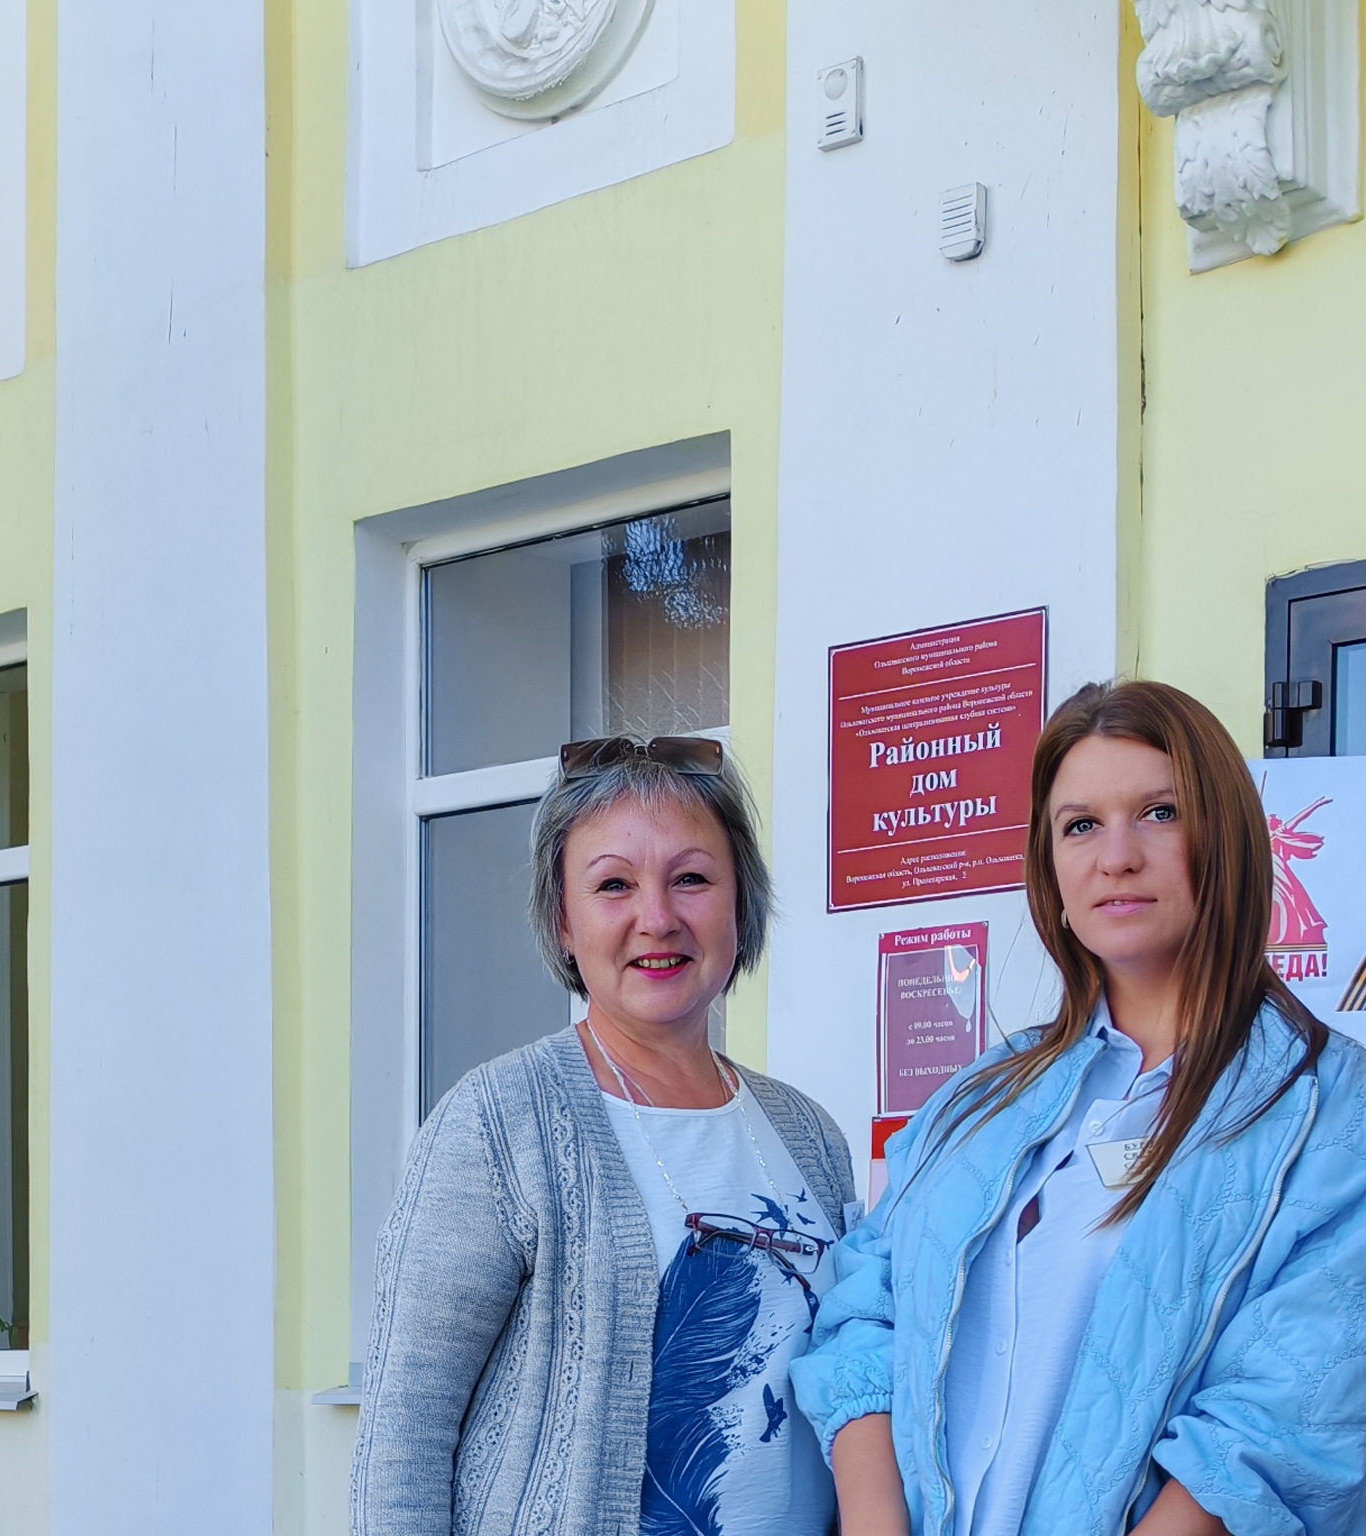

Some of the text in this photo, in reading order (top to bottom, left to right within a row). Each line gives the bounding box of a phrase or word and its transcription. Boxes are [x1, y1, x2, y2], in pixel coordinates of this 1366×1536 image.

[869, 722, 1002, 769] Районный
[909, 768, 958, 798] дом
[872, 795, 998, 837] культуры
[893, 928, 972, 947] Режим работы
[1265, 953, 1328, 982] ЕДА!
